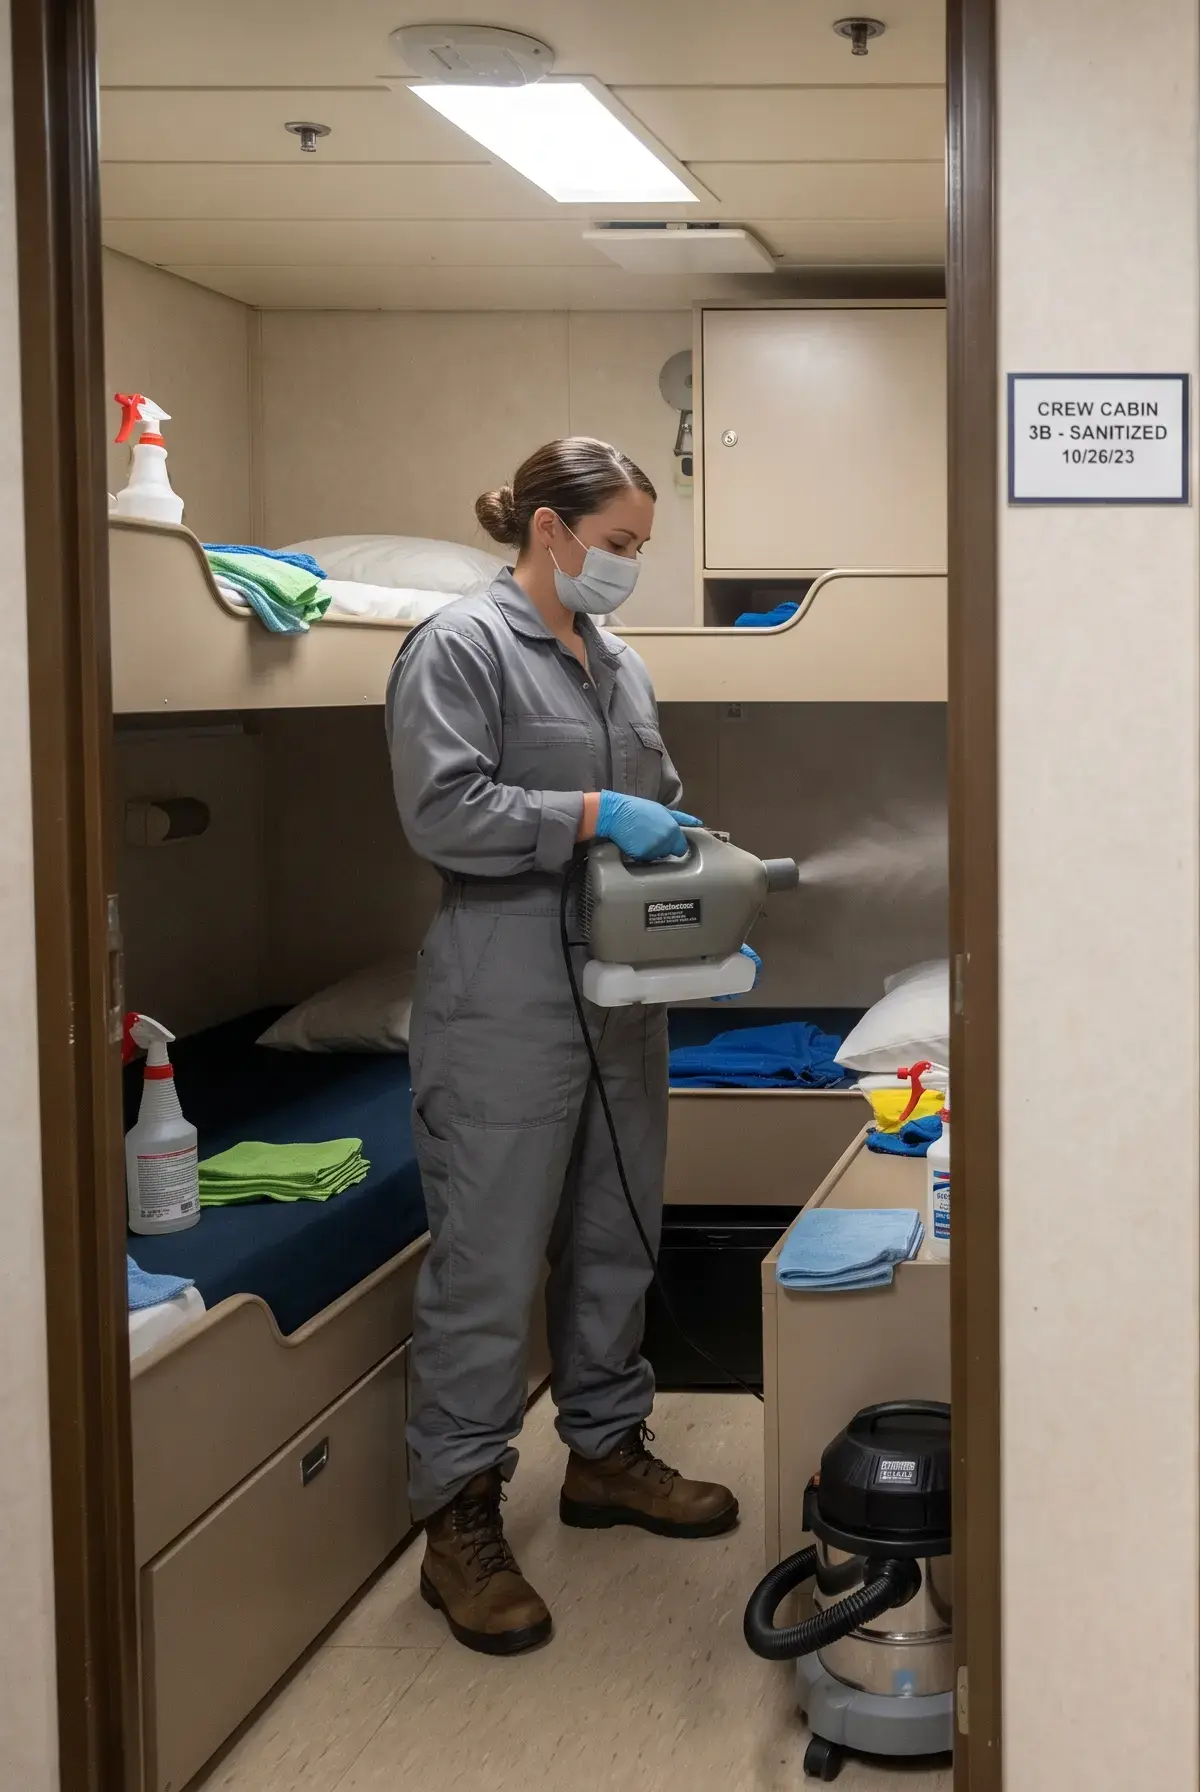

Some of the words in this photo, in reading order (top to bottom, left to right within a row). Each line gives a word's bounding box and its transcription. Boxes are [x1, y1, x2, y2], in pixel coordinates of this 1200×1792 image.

[1037, 401, 1094, 417] CREW
[1100, 401, 1158, 417] CABIN
[1028, 424, 1052, 441] 3B
[1069, 424, 1168, 441] SANITIZED
[1062, 448, 1135, 465] 10/26/23
